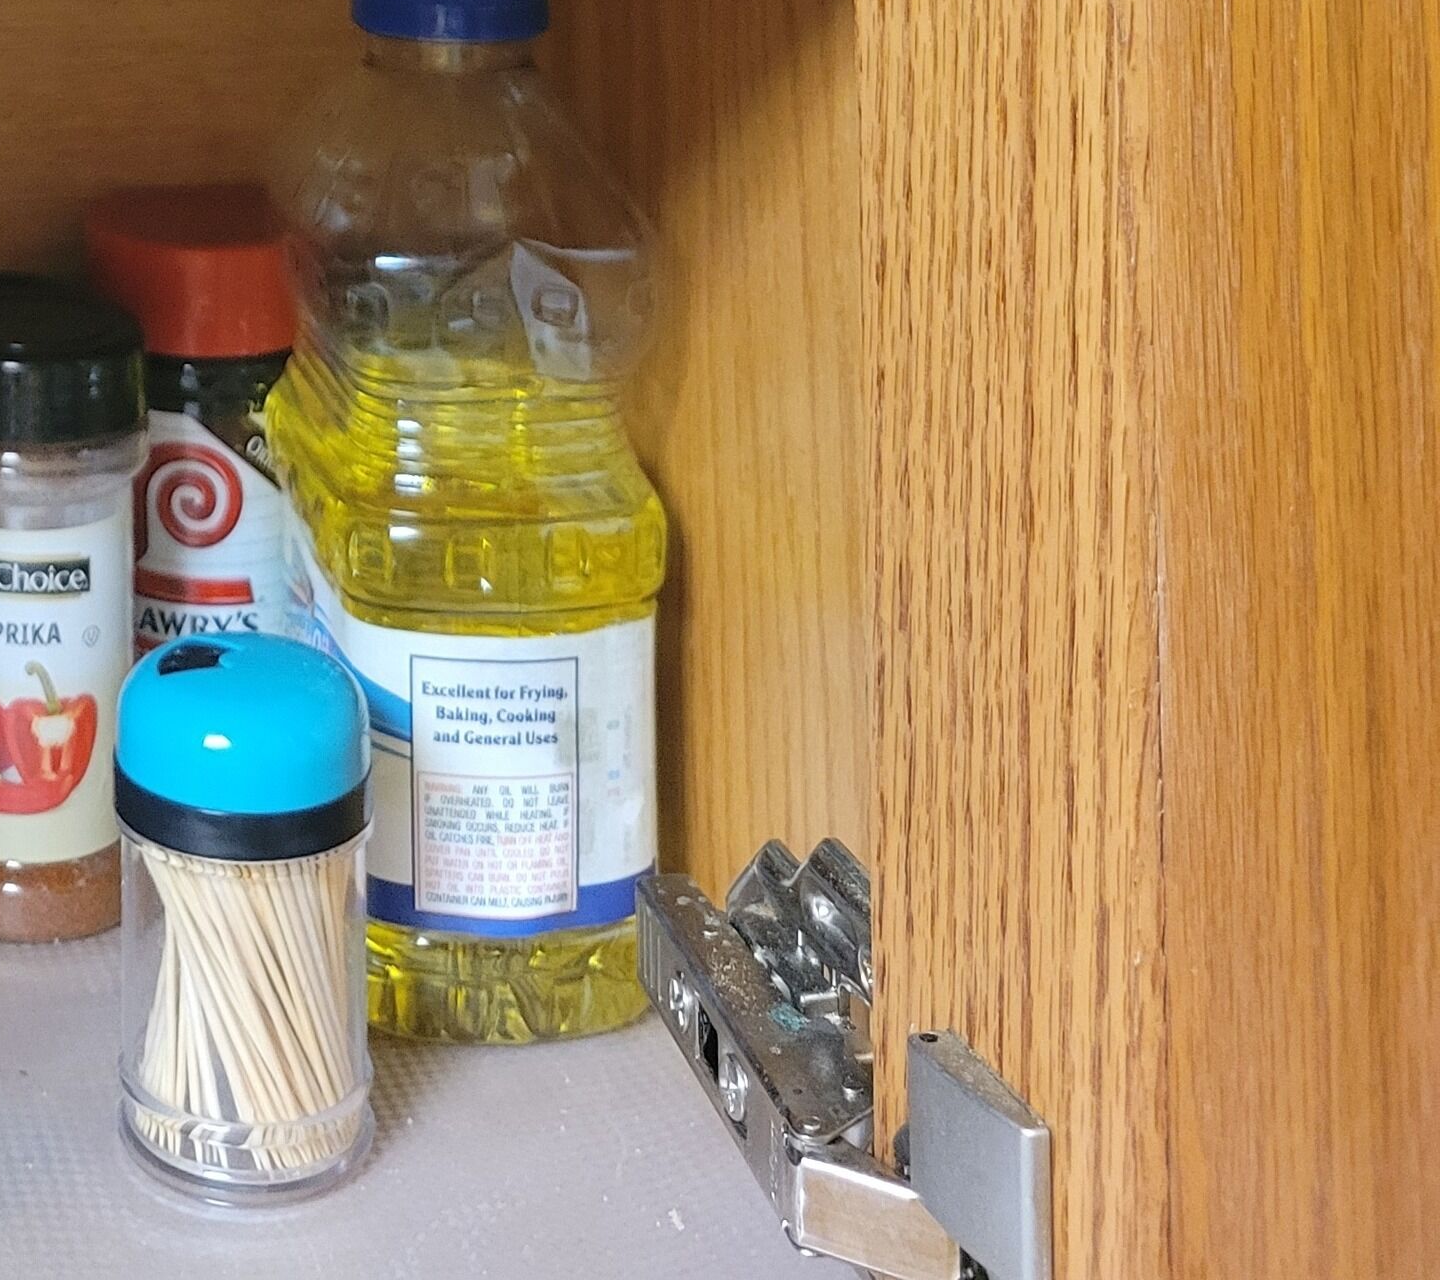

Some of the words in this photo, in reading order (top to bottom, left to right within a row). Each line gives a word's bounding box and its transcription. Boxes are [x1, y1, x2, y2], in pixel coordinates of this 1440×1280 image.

[138, 605, 260, 637] AWRY'S
[421, 680, 492, 700] Excellent
[494, 685, 516, 700] for
[520, 684, 569, 703] Frying,
[435, 705, 494, 725] Baking,
[496, 708, 557, 724] Cooking
[433, 729, 460, 744] and
[464, 730, 522, 746] General
[526, 731, 559, 745] Uses
[472, 784, 488, 795] ANY
[498, 784, 512, 796] OIL
[521, 784, 539, 796] WILL
[549, 783, 569, 793] BURN
[502, 797, 514, 809] DO
[523, 796, 538, 808] NOT
[548, 794, 569, 805] LEAVE
[424, 806, 476, 819] UNATTENDED
[486, 810, 509, 821] WHILE
[424, 818, 461, 830] SMOKING
[505, 822, 535, 833] REDUCE
[470, 895, 487, 907] CAN
[511, 895, 543, 908] CAUSING
